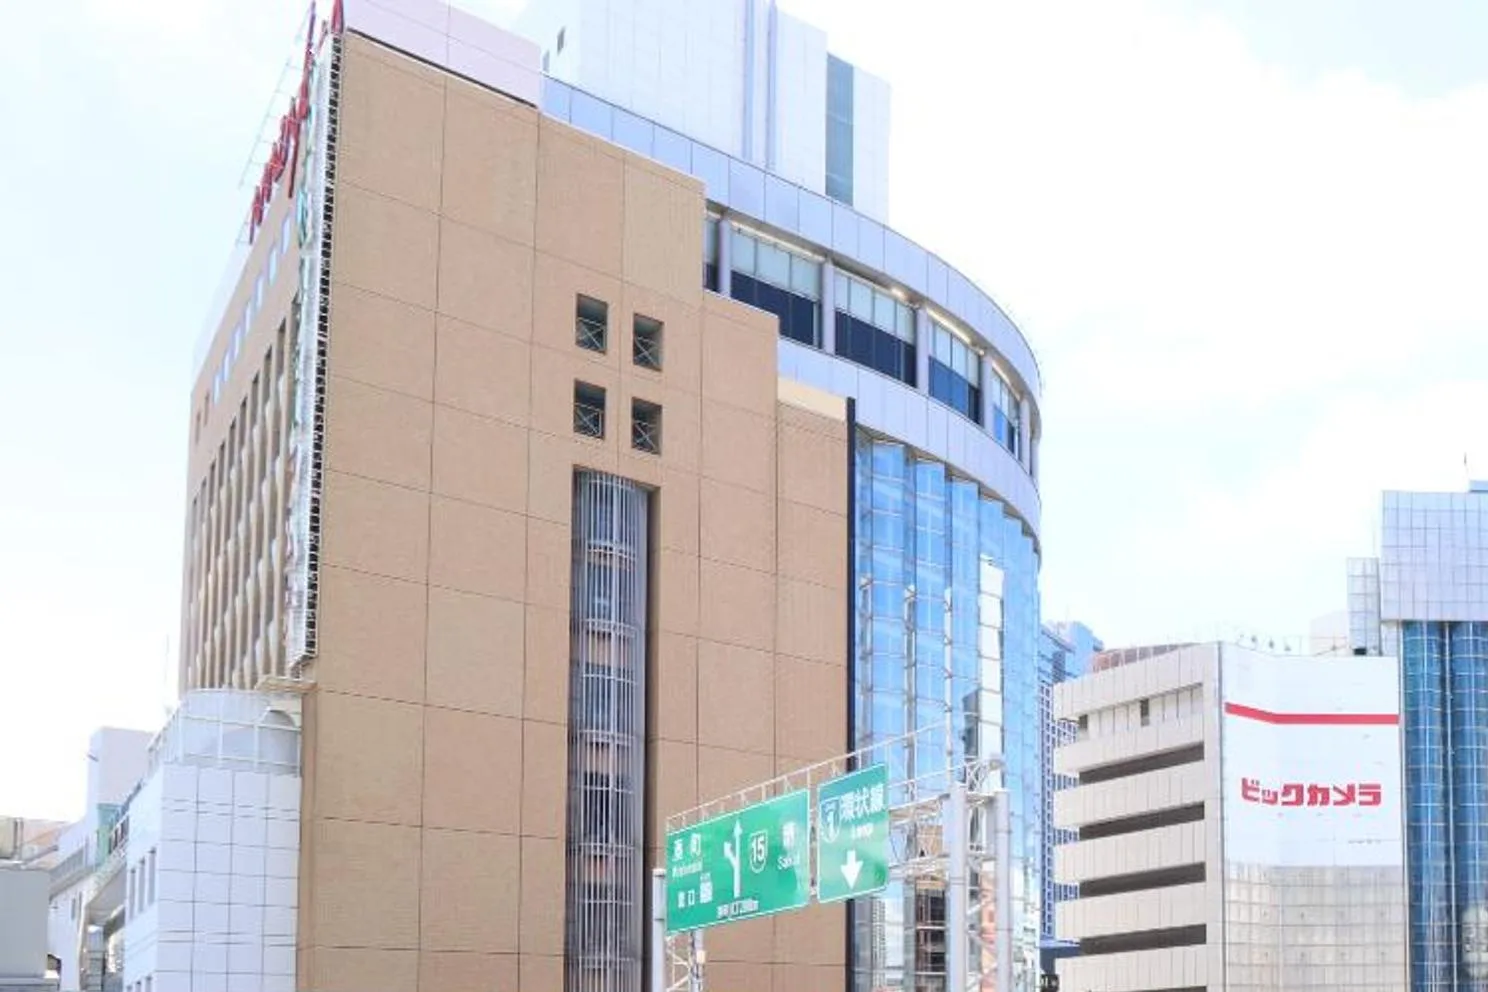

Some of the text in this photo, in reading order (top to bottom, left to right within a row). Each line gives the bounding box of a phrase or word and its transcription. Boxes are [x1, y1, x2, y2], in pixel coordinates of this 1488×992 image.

[1241, 777, 1382, 806] ビックカメラ
[751, 836, 765, 862] 15
